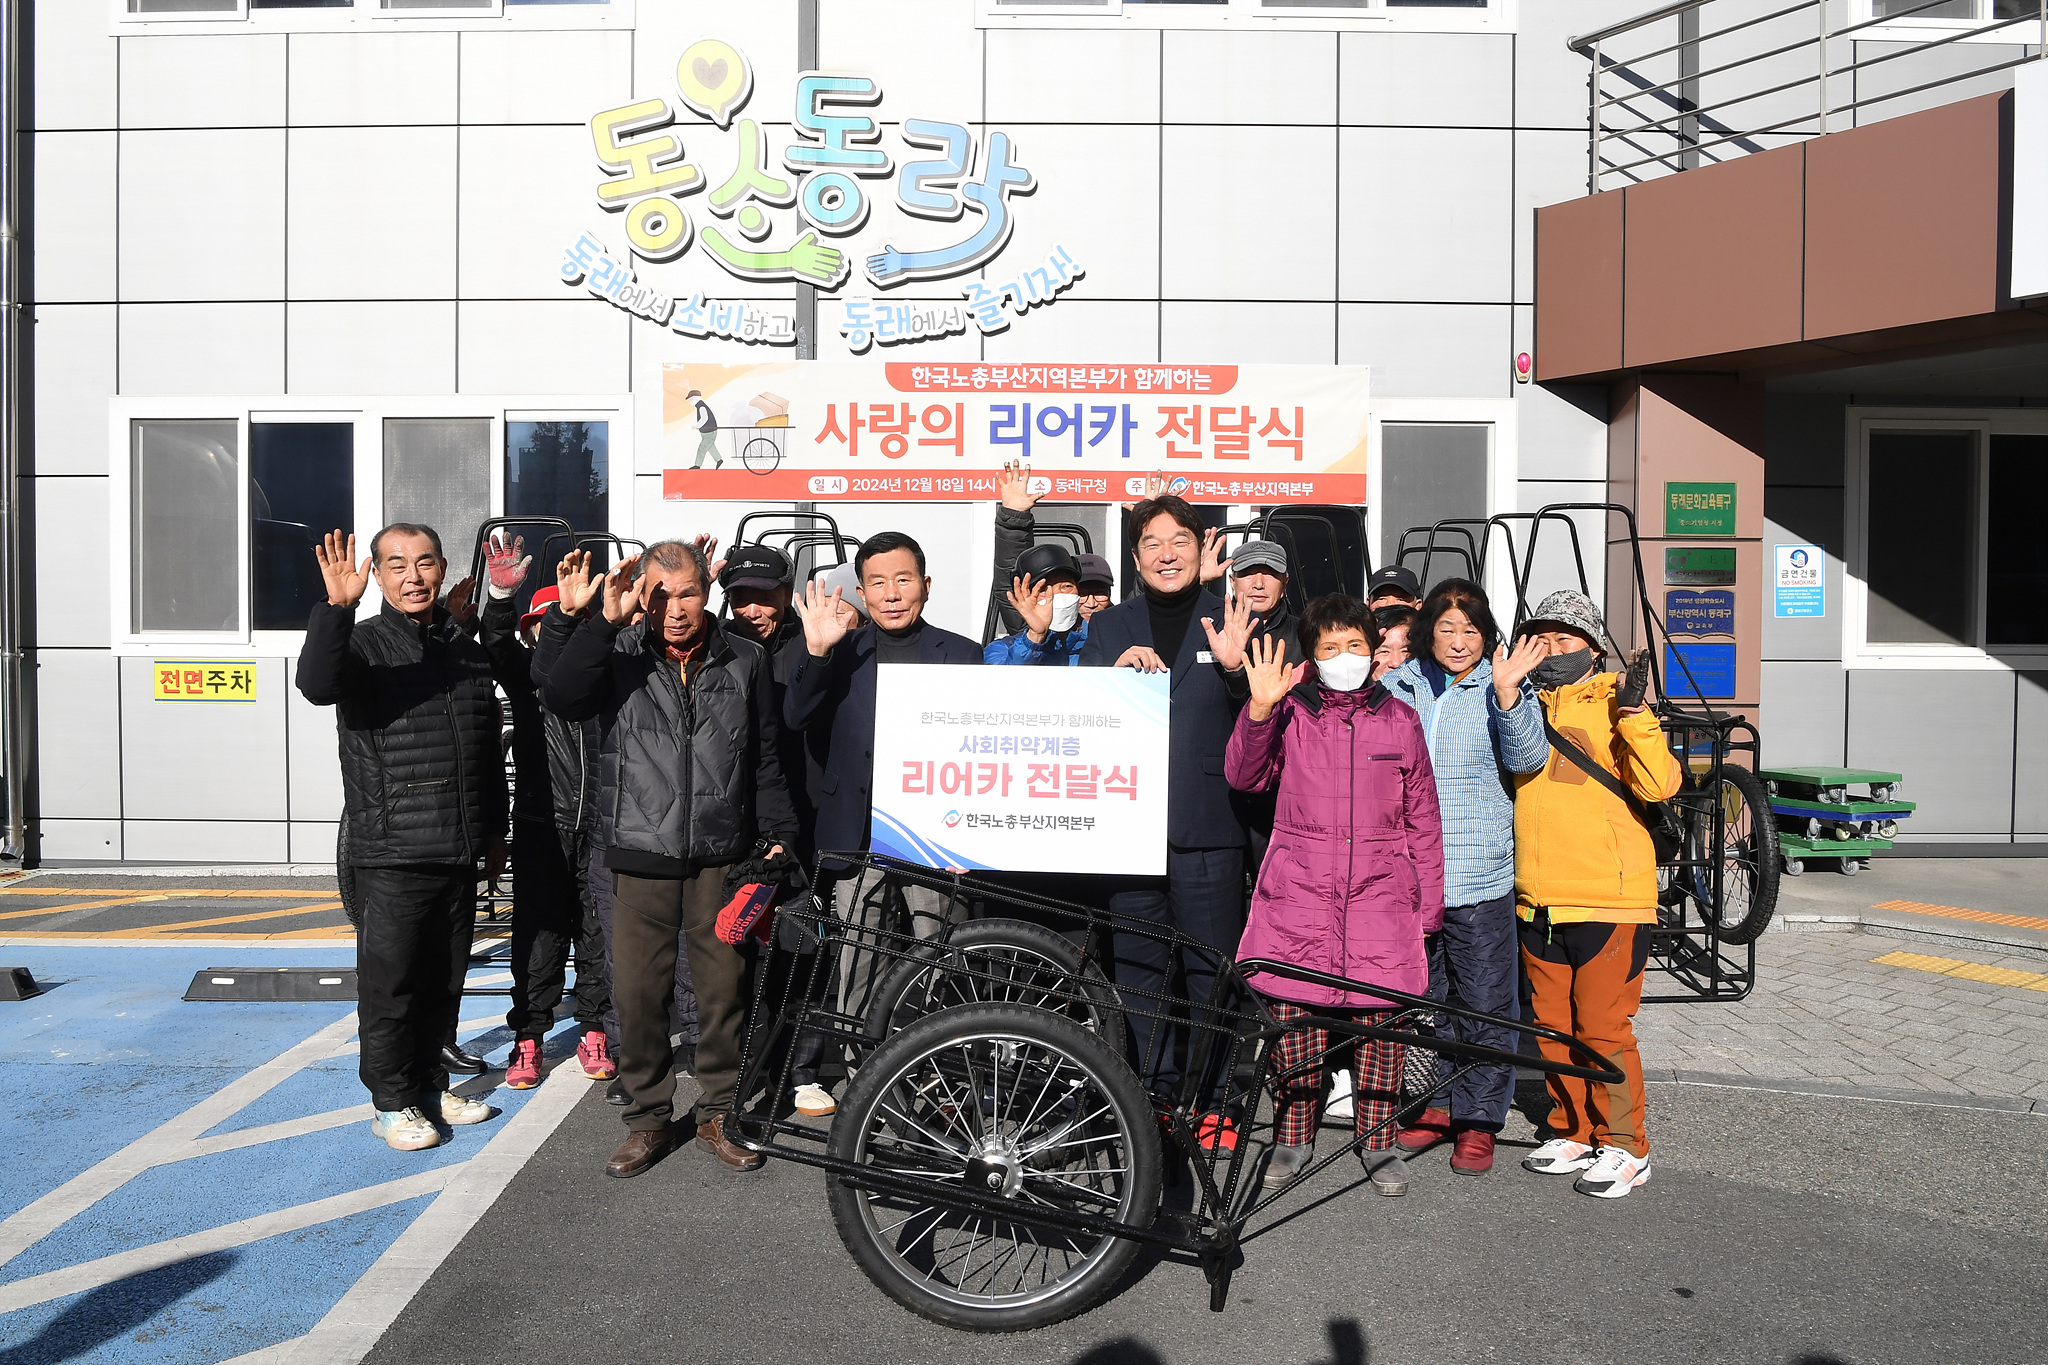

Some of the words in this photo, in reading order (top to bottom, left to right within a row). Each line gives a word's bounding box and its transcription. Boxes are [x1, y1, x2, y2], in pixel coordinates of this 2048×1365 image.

[561, 235, 669, 317] 동래에서
[675, 294, 791, 338] 소비하고
[842, 302, 960, 345] 동래에서
[965, 245, 1080, 327] 즐기자!
[910, 366, 1128, 391] 한국노총부산지역본부가
[1133, 368, 1212, 391] 함께하는
[813, 402, 965, 460] 사랑의
[989, 402, 1139, 459] 리어카
[1155, 405, 1304, 462] 전달식
[851, 477, 902, 493] 2024년
[904, 477, 933, 493] 12월
[935, 477, 965, 493] 18일
[966, 477, 997, 493] 14시
[1054, 478, 1107, 493] 동래구청
[1192, 480, 1314, 497] 한국노총부산지역본부
[1671, 493, 1731, 510] 동래문화교육특구
[1781, 569, 1817, 579] 금연건물
[1669, 608, 1707, 619] 부산광역시
[1708, 608, 1732, 619] 동래구
[160, 669, 252, 694] 전면주차
[921, 710, 1065, 727] 한국노총부산지역본부가
[1068, 713, 1122, 729] 함께하는
[958, 735, 1081, 756] 사회취약계층
[901, 760, 1014, 798] 리어카
[1026, 763, 1138, 801] 전달식
[966, 812, 1096, 831] 한국노총부산지역본부
[735, 902, 762, 941] SPORTS
